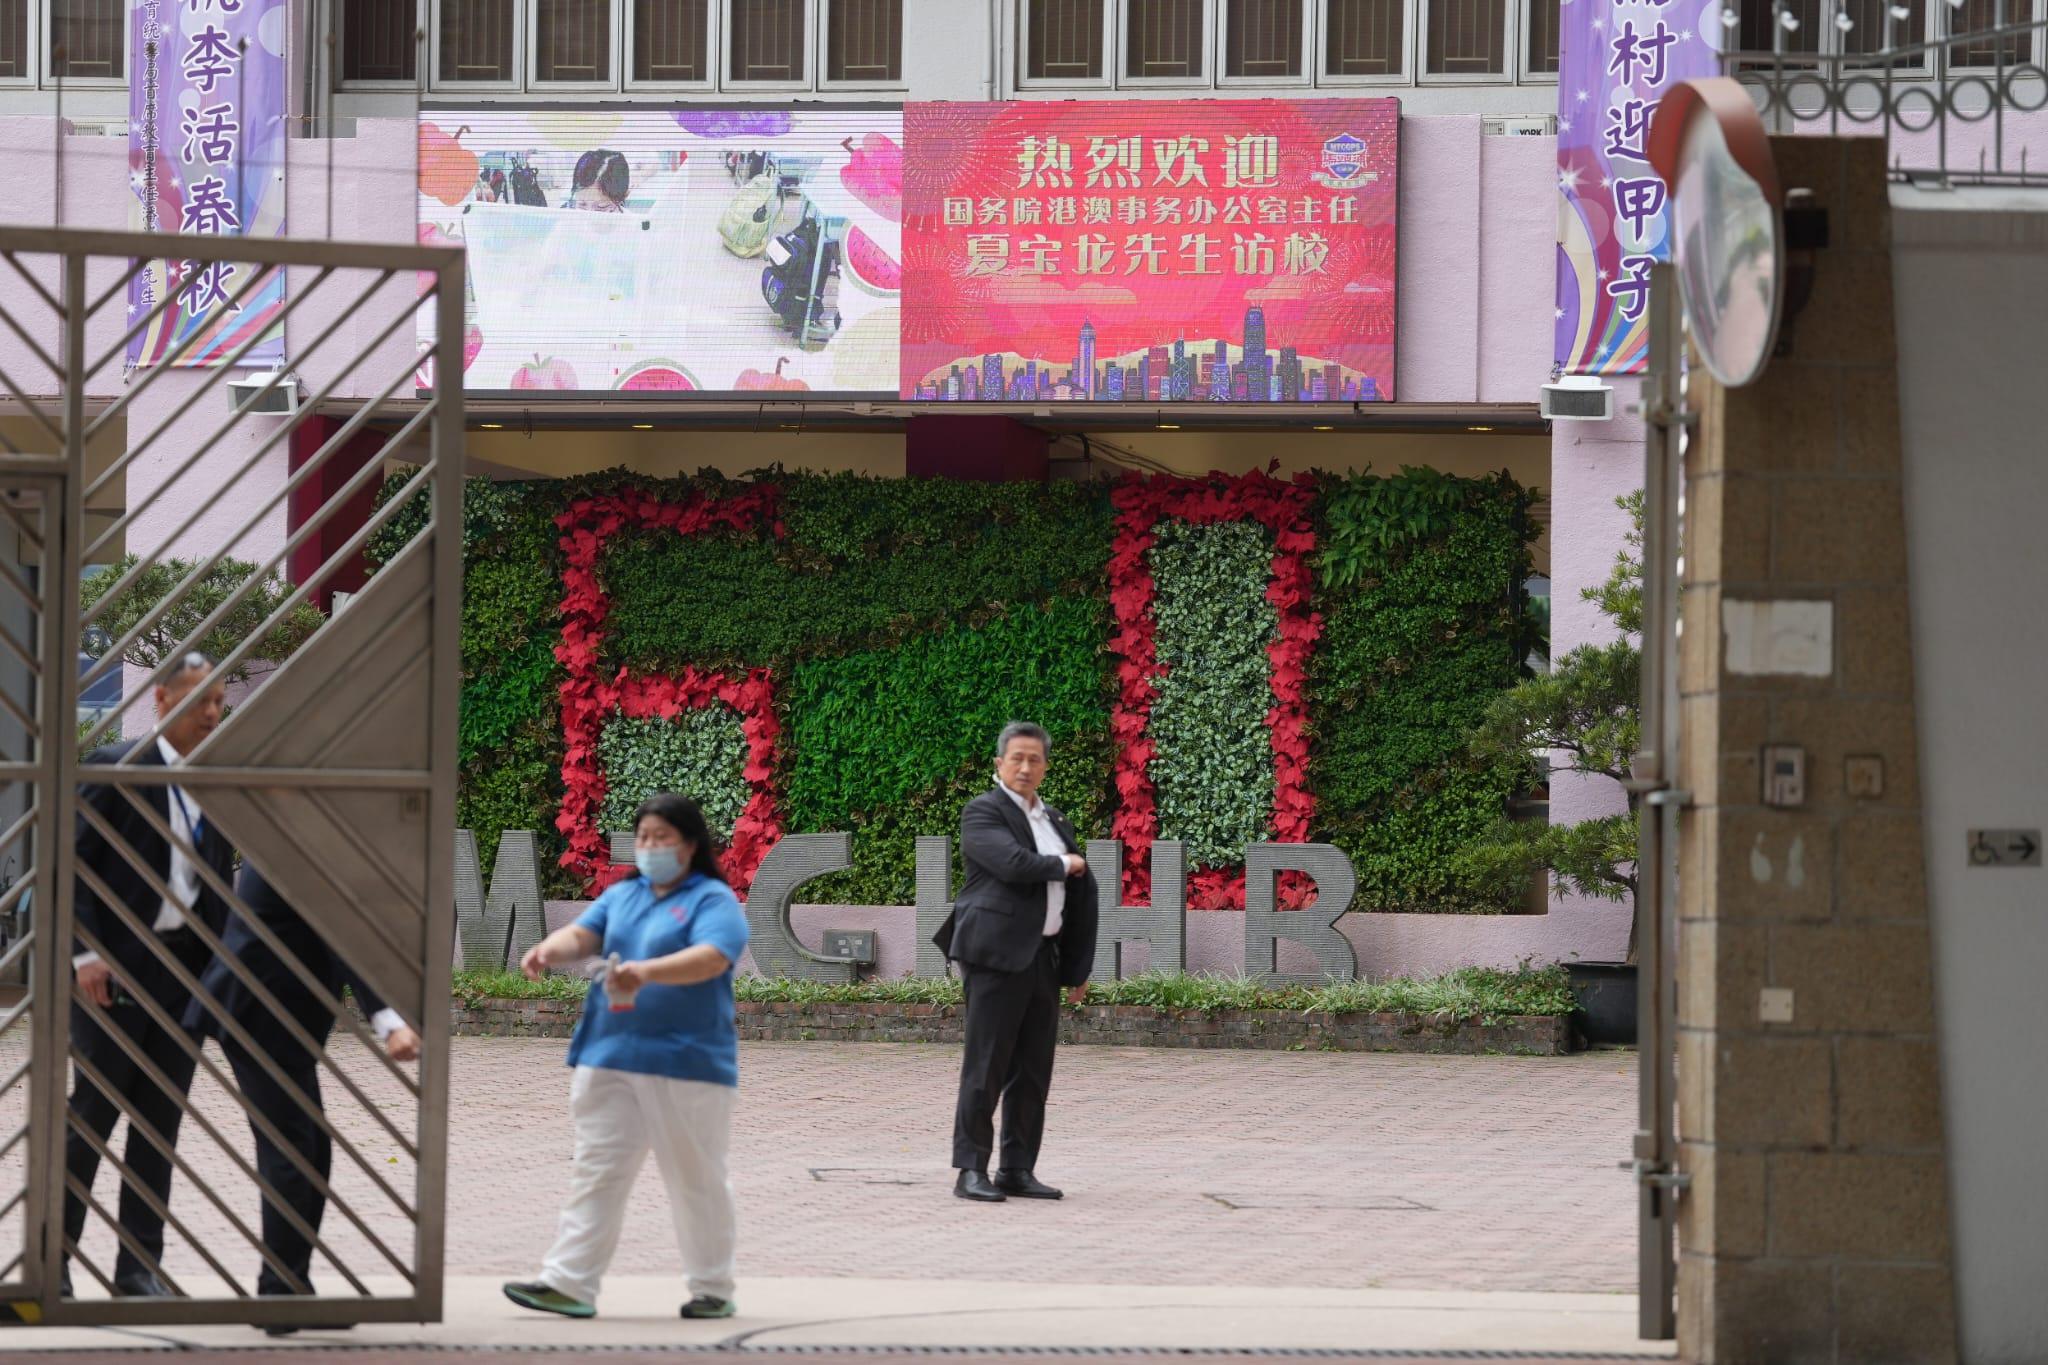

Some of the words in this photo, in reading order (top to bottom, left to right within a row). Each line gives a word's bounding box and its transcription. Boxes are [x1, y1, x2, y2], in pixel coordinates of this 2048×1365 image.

[179, 0, 241, 314] 李活春秋
[1016, 134, 1281, 188] 热烈欢迎
[1607, 0, 1677, 319] 村迎甲子
[943, 197, 1359, 226] 国务院港澳事务办公室主任
[966, 232, 1330, 277] 夏宝龙先生访校
